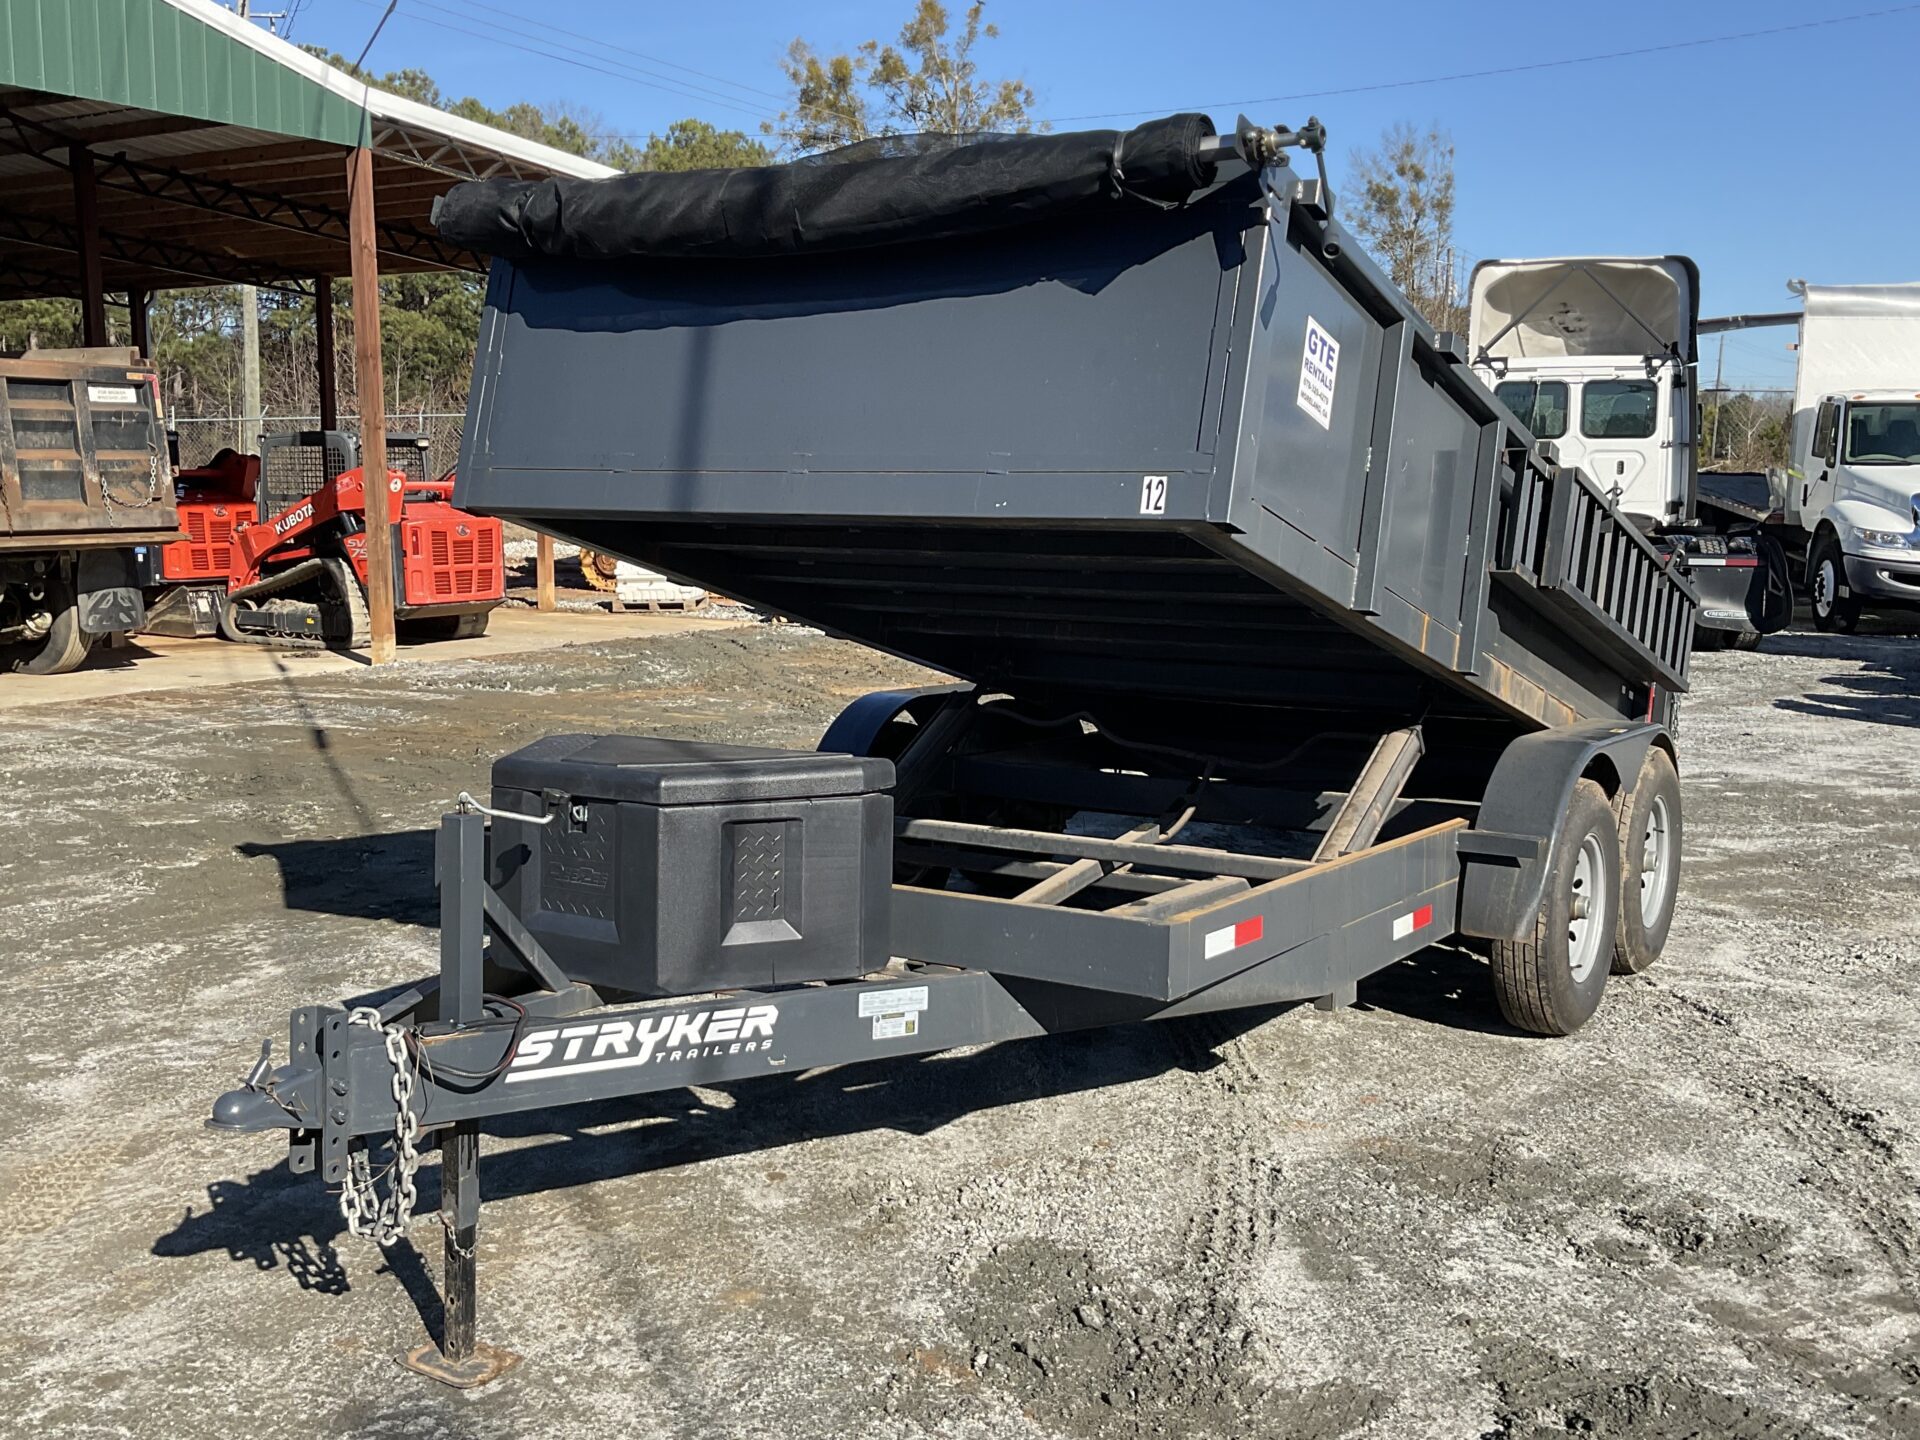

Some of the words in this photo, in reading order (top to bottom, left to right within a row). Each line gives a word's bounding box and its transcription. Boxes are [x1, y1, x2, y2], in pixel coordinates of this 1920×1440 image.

[1308, 328, 1335, 372] GTE
[1305, 357, 1332, 391] RENTALS
[1145, 478, 1165, 510] 12
[275, 503, 316, 535] KUBOTA
[510, 1005, 780, 1070] STRYKER
[655, 1039, 773, 1063] TRAILERS
